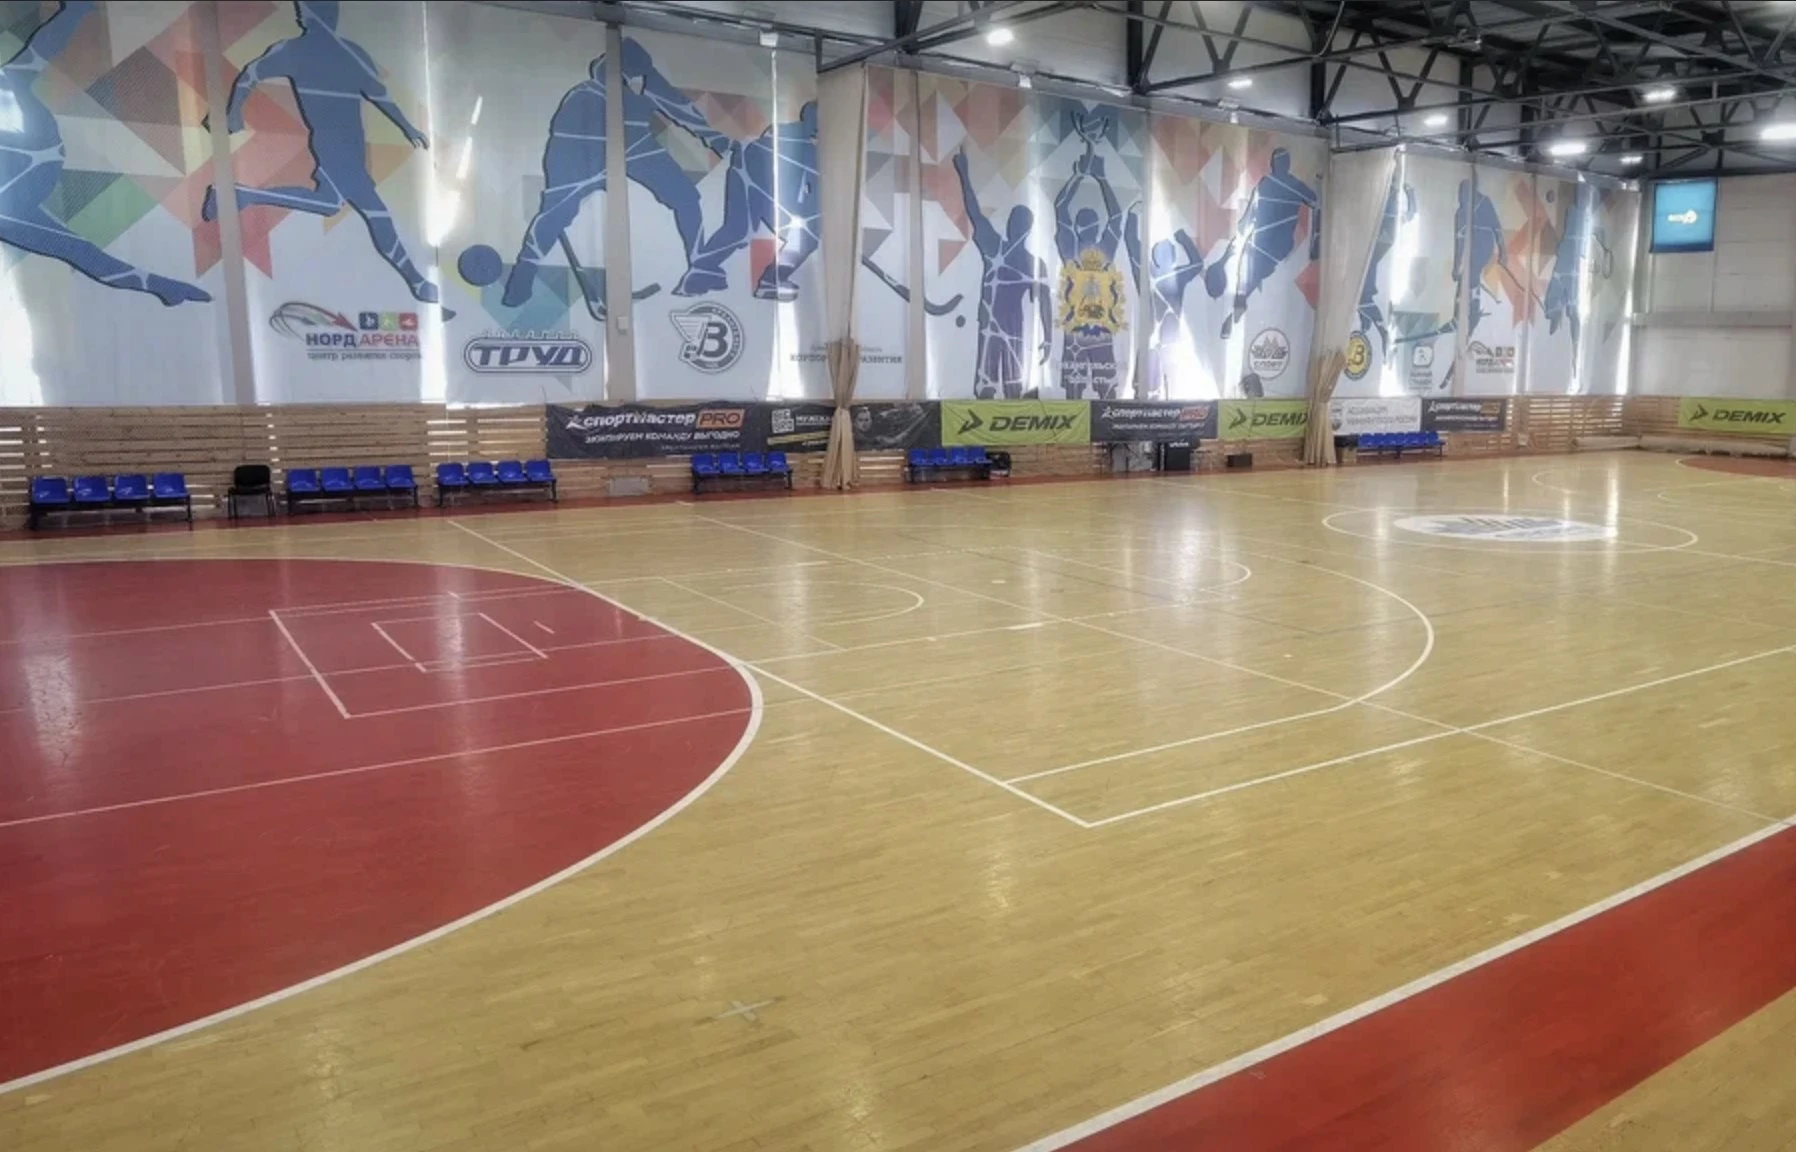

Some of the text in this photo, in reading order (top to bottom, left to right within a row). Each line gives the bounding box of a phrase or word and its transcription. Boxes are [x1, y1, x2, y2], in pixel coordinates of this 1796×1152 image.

[306, 333, 357, 347] НОРД
[471, 346, 584, 366] ТРУД
[700, 412, 741, 426] PRO
[989, 414, 1077, 431] DEMIX
[1712, 409, 1787, 424] DEMIX
